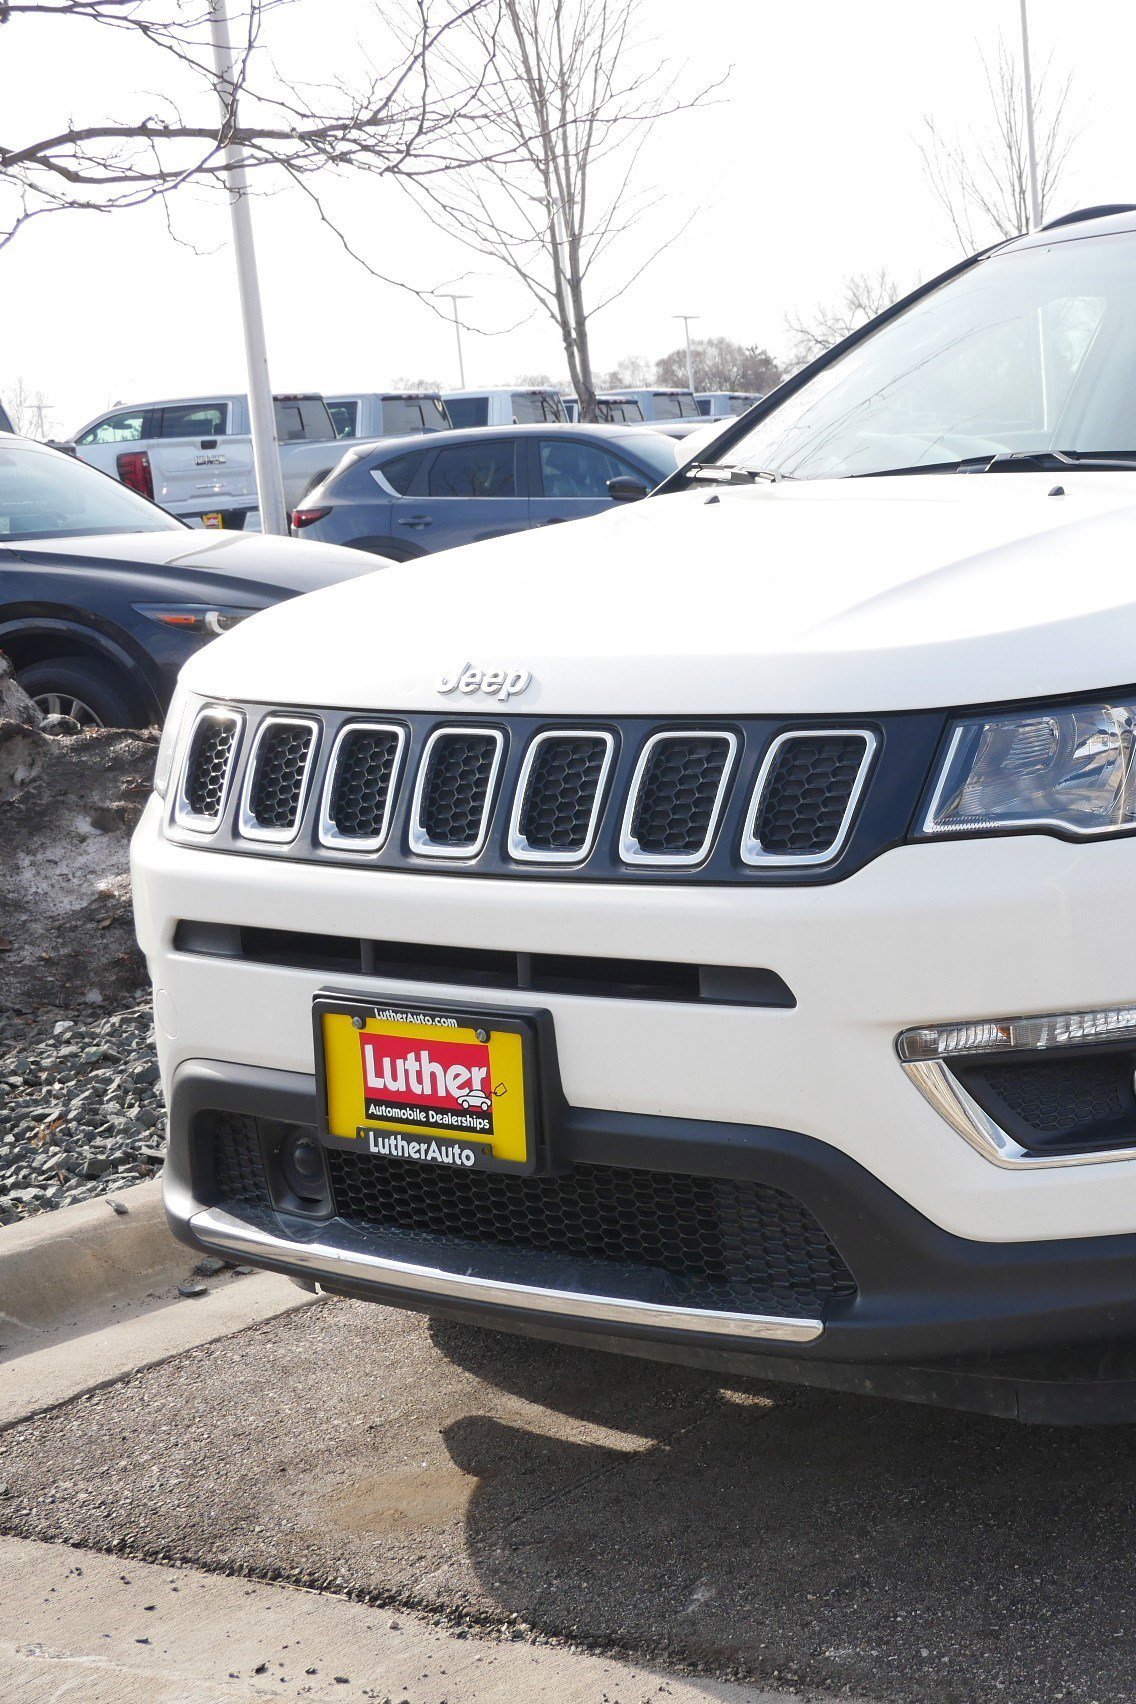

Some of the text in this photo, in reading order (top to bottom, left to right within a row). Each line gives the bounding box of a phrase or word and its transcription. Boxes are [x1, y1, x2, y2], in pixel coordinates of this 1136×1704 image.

[436, 662, 533, 702] Jeep
[374, 1008, 458, 1027] LutherAuto.com
[364, 1044, 487, 1099] Luther
[368, 1103, 490, 1131] Automobile Dealerships
[369, 1131, 475, 1167] LutherAuto
